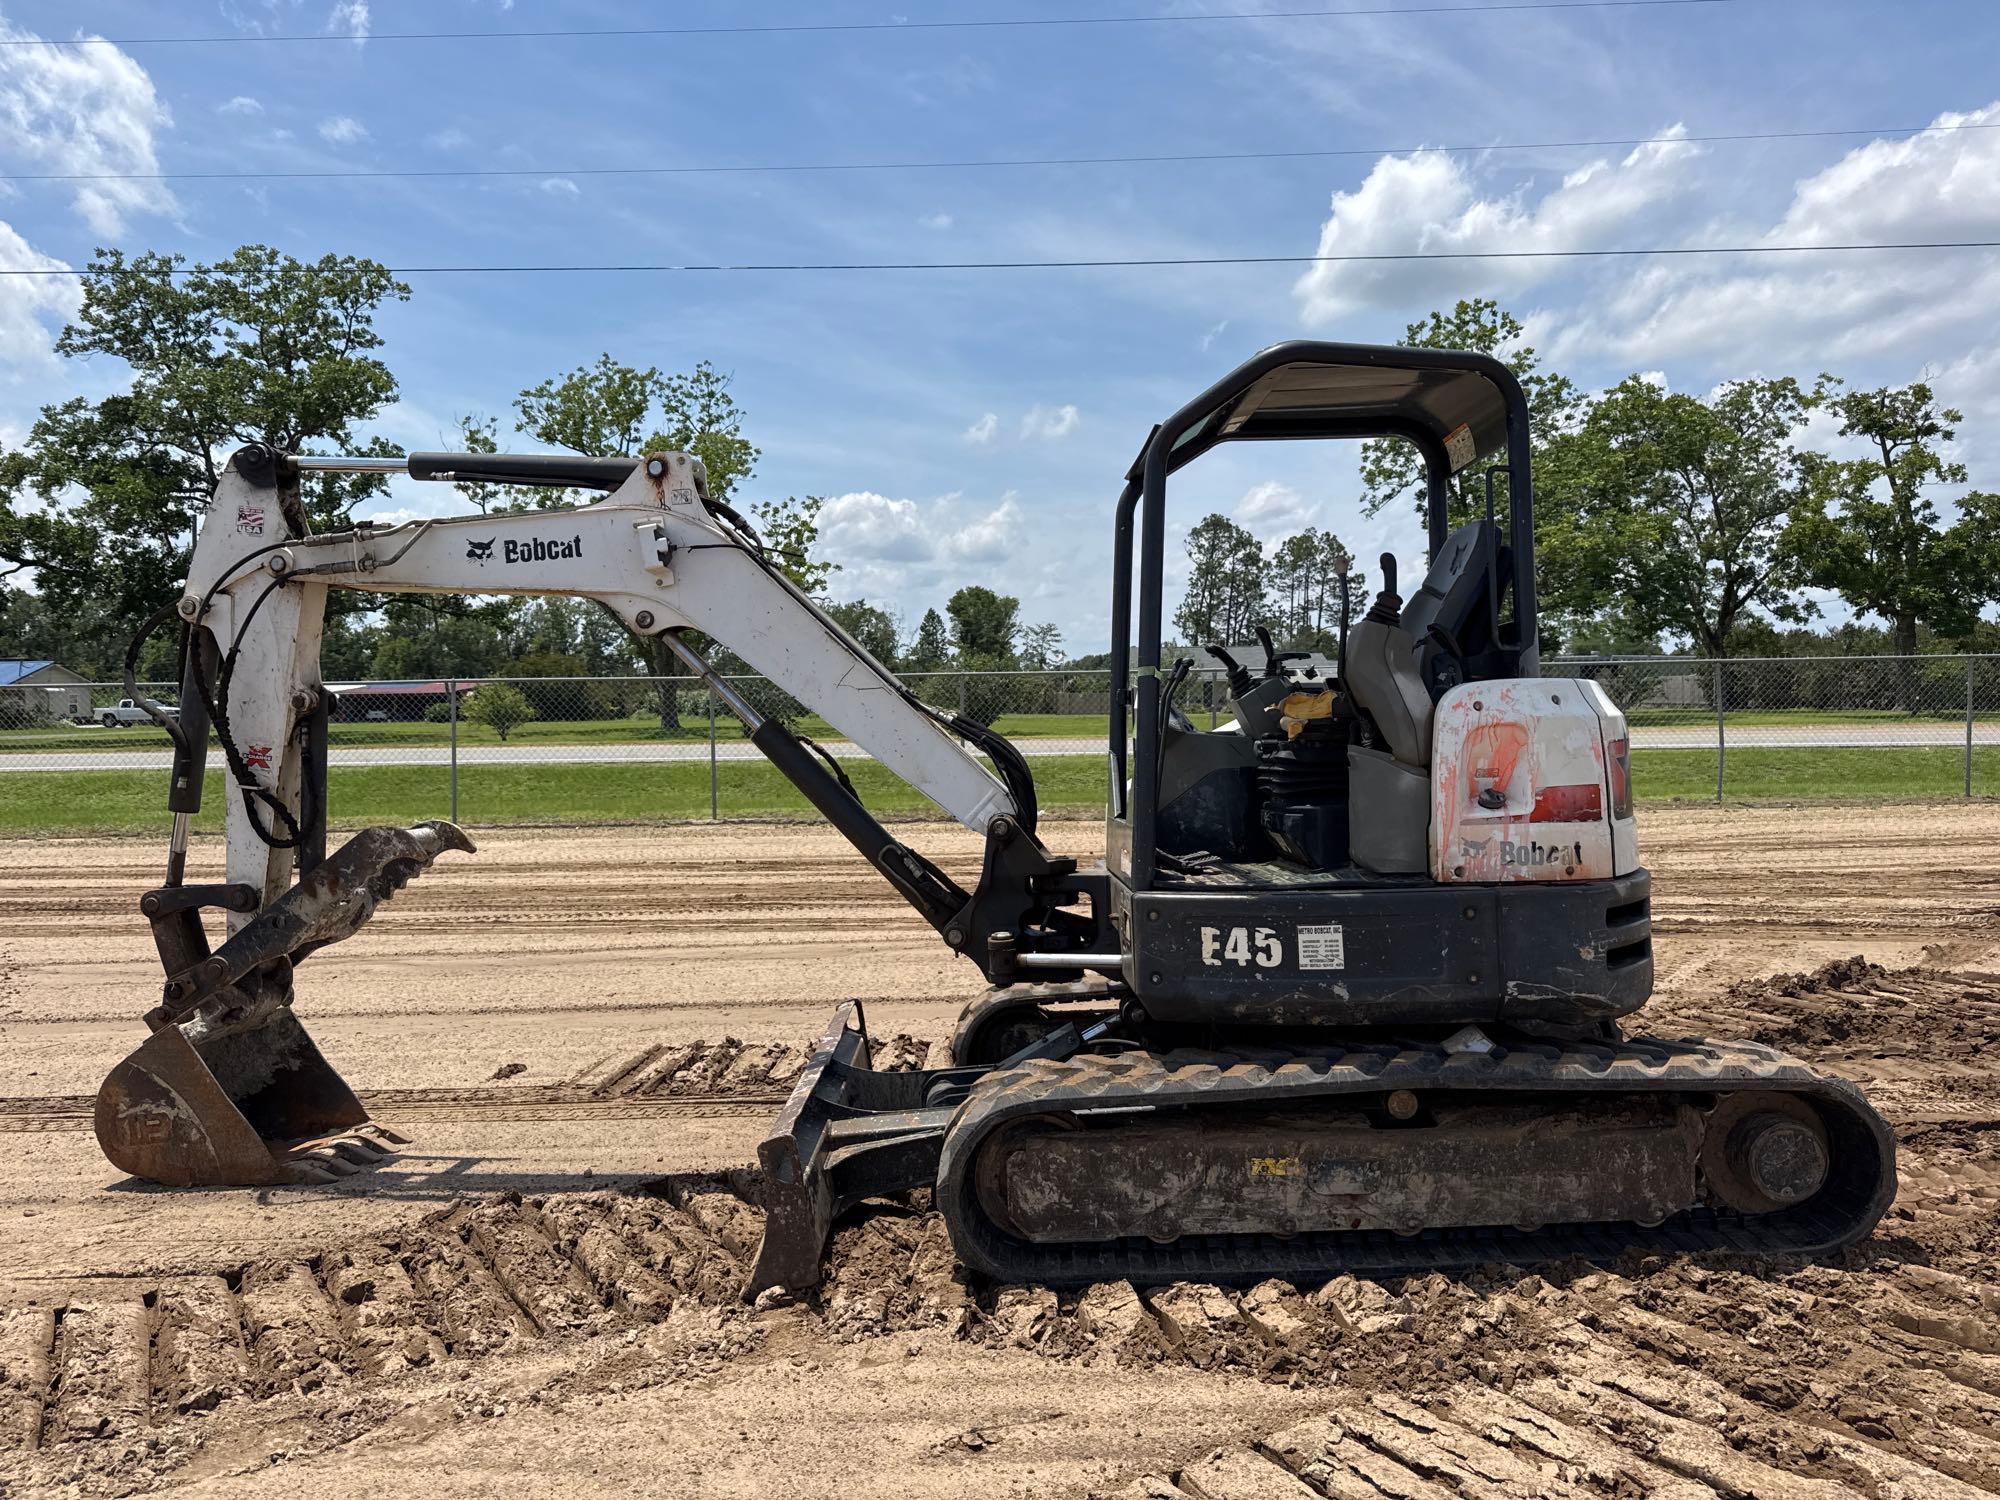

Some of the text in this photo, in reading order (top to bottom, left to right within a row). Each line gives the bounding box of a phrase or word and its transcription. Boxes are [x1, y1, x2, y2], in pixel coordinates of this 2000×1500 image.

[238, 525, 261, 534] USA
[504, 534, 582, 564] Bobcat
[1500, 841, 1582, 866] Bobcat
[1200, 926, 1283, 968] E45
